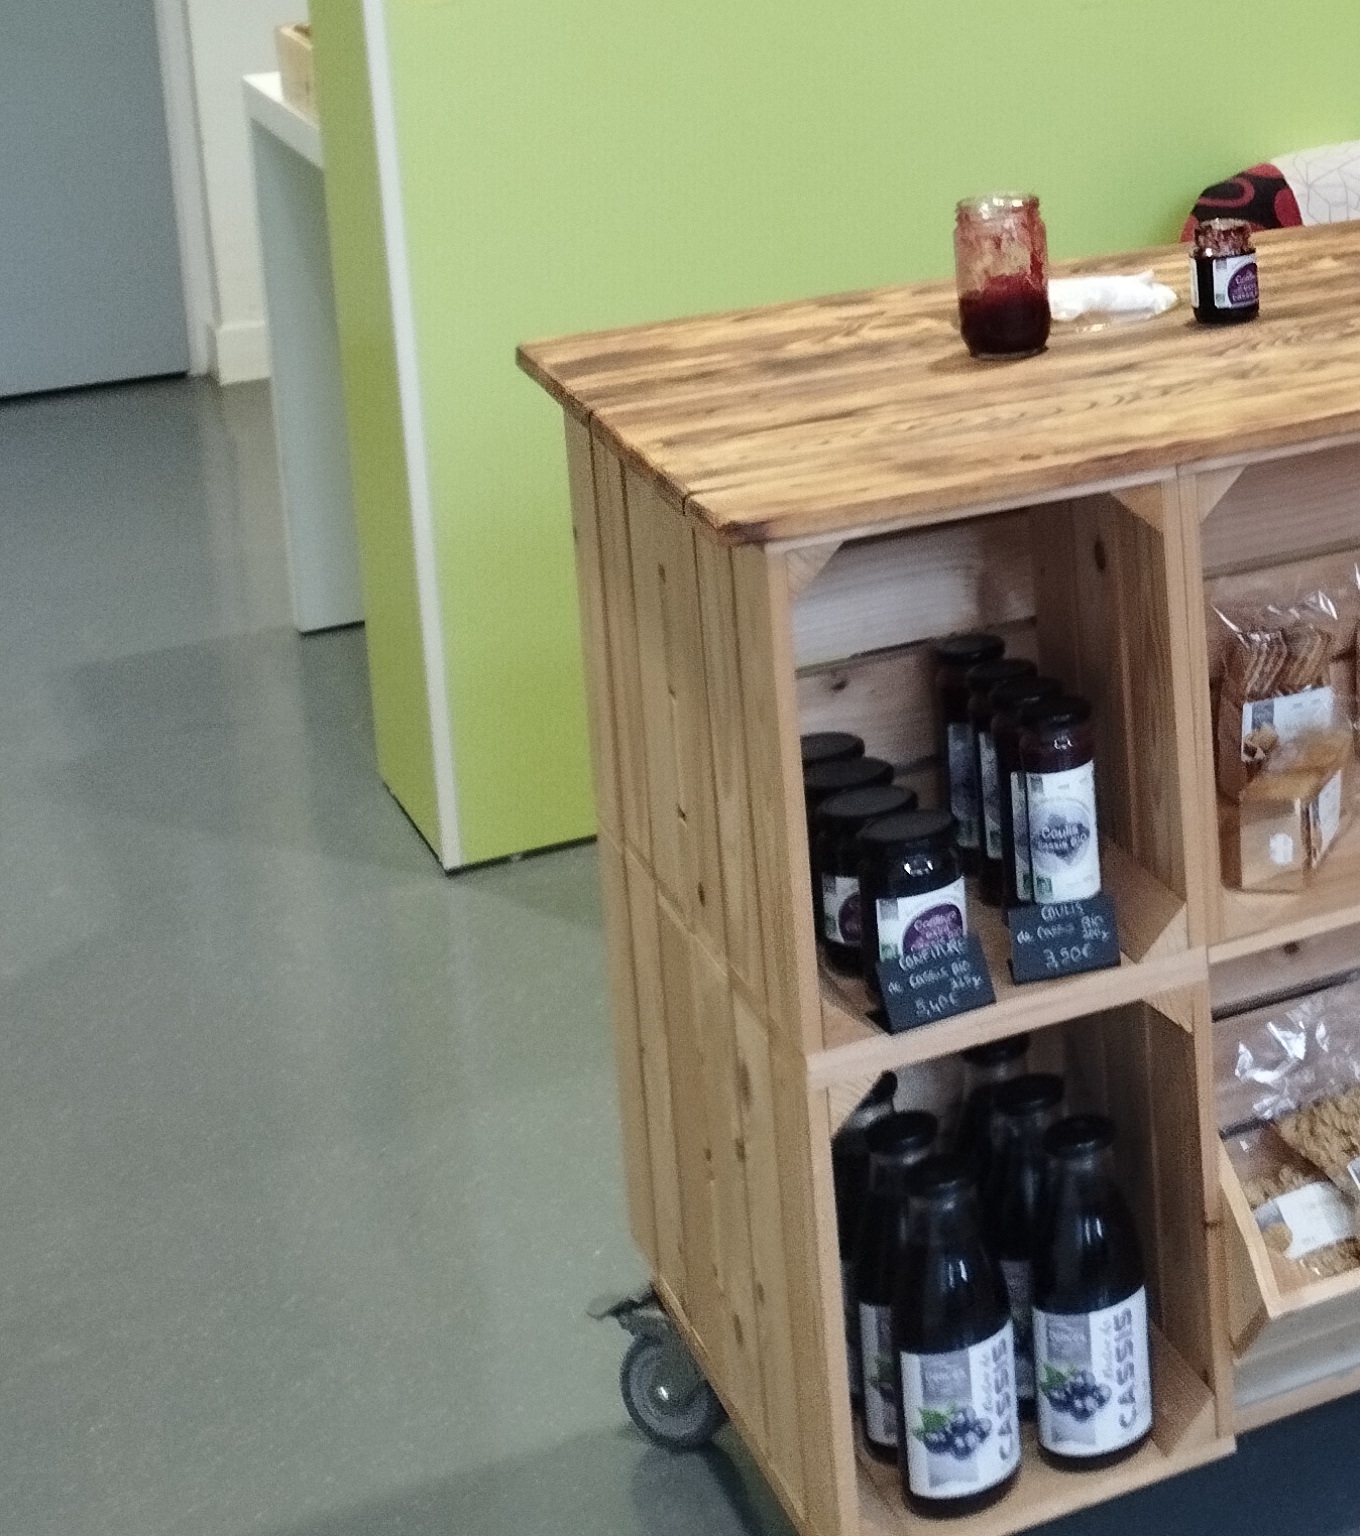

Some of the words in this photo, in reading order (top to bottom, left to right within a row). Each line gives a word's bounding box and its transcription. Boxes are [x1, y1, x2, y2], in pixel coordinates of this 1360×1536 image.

[1041, 901, 1084, 922] COULIS
[991, 1337, 1013, 1462] CASSIS
[1112, 1307, 1138, 1429] CASSIS
